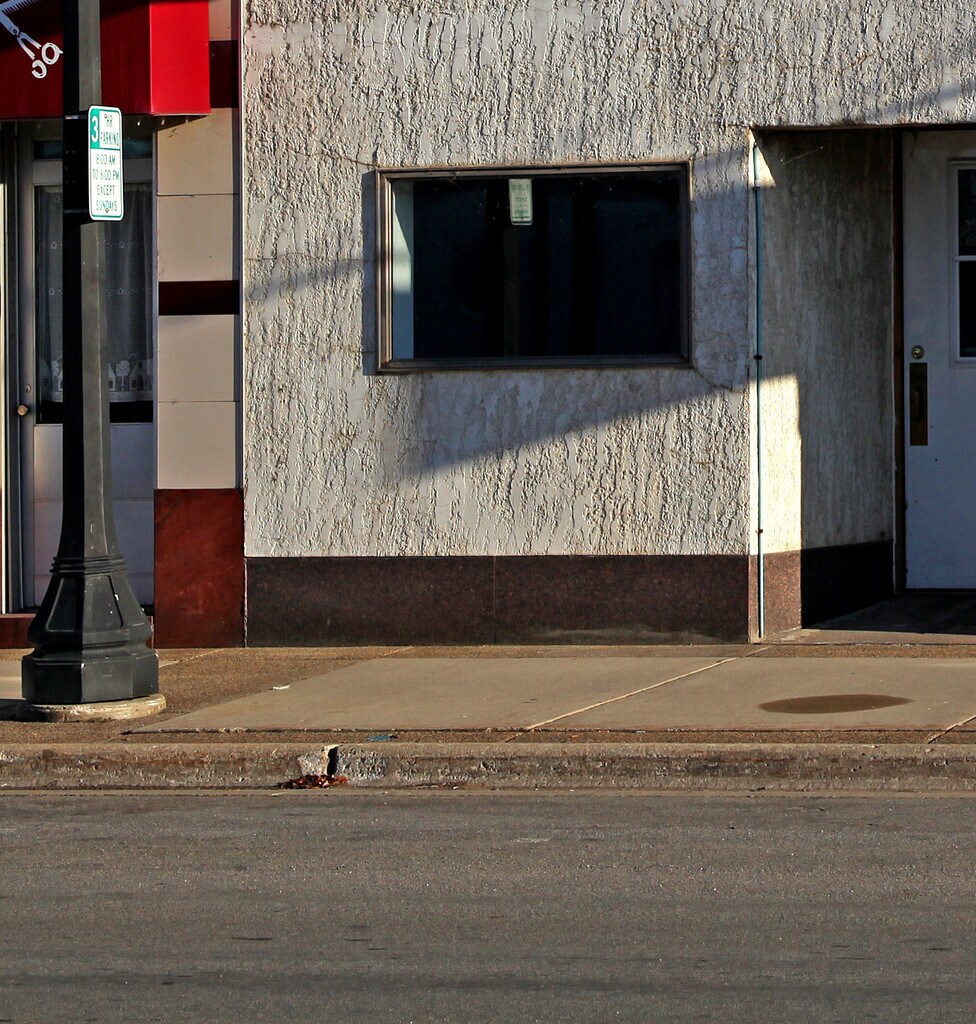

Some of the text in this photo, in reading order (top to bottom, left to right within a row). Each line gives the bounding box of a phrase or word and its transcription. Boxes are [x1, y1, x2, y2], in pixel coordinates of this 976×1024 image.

[91, 115, 99, 143] 3
[100, 131, 119, 146] PARKING
[109, 154, 116, 166] AM
[92, 168, 99, 180] TO
[112, 169, 120, 181] PM
[96, 184, 115, 196] EXCEPT
[95, 199, 118, 212] SUNDAYS
